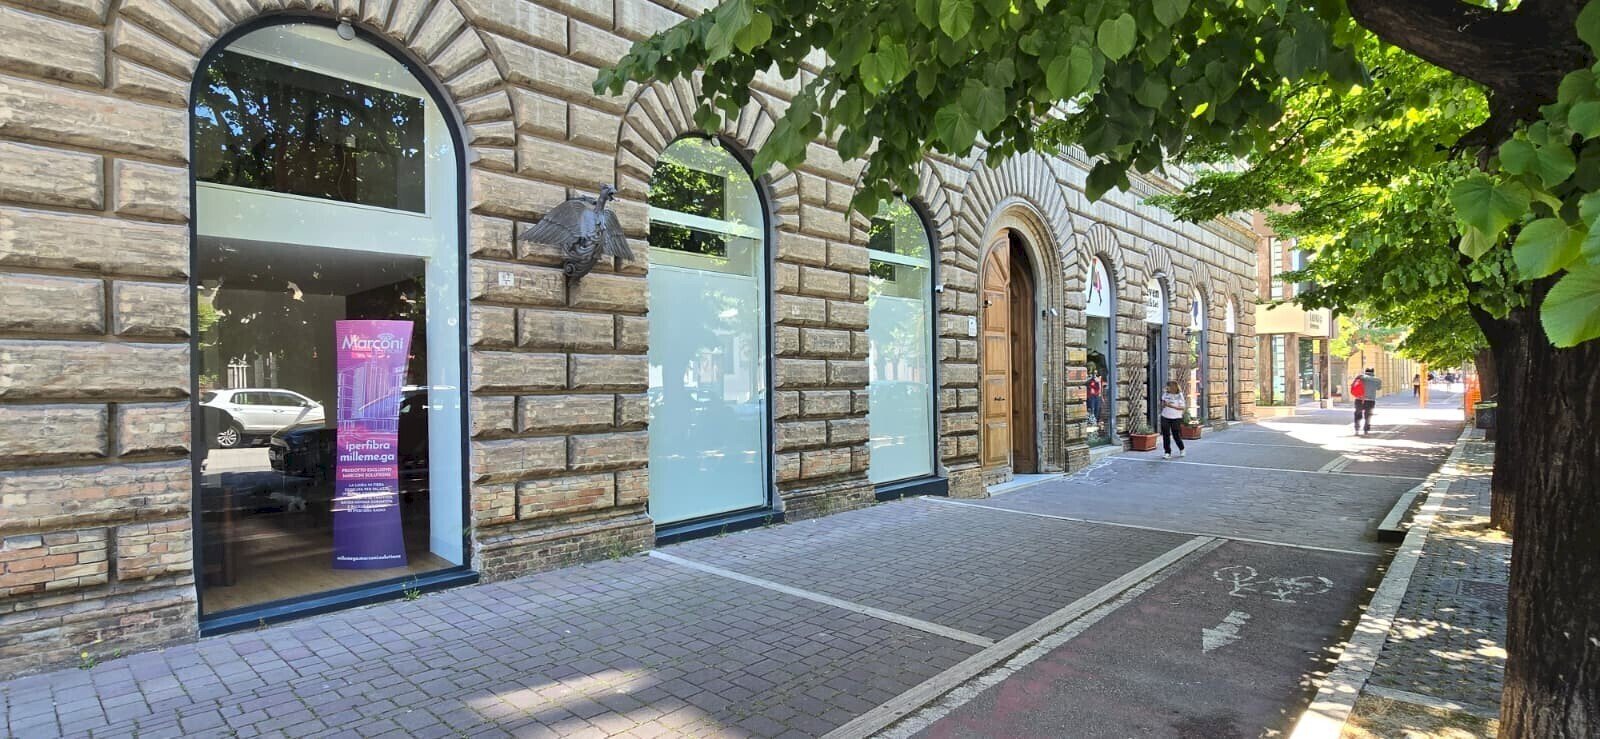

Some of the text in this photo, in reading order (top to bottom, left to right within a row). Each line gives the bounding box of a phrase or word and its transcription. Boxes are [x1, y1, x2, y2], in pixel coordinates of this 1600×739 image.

[342, 335, 404, 350] Marconi
[345, 440, 391, 452] iperfibra
[340, 451, 395, 463] milleme.ga
